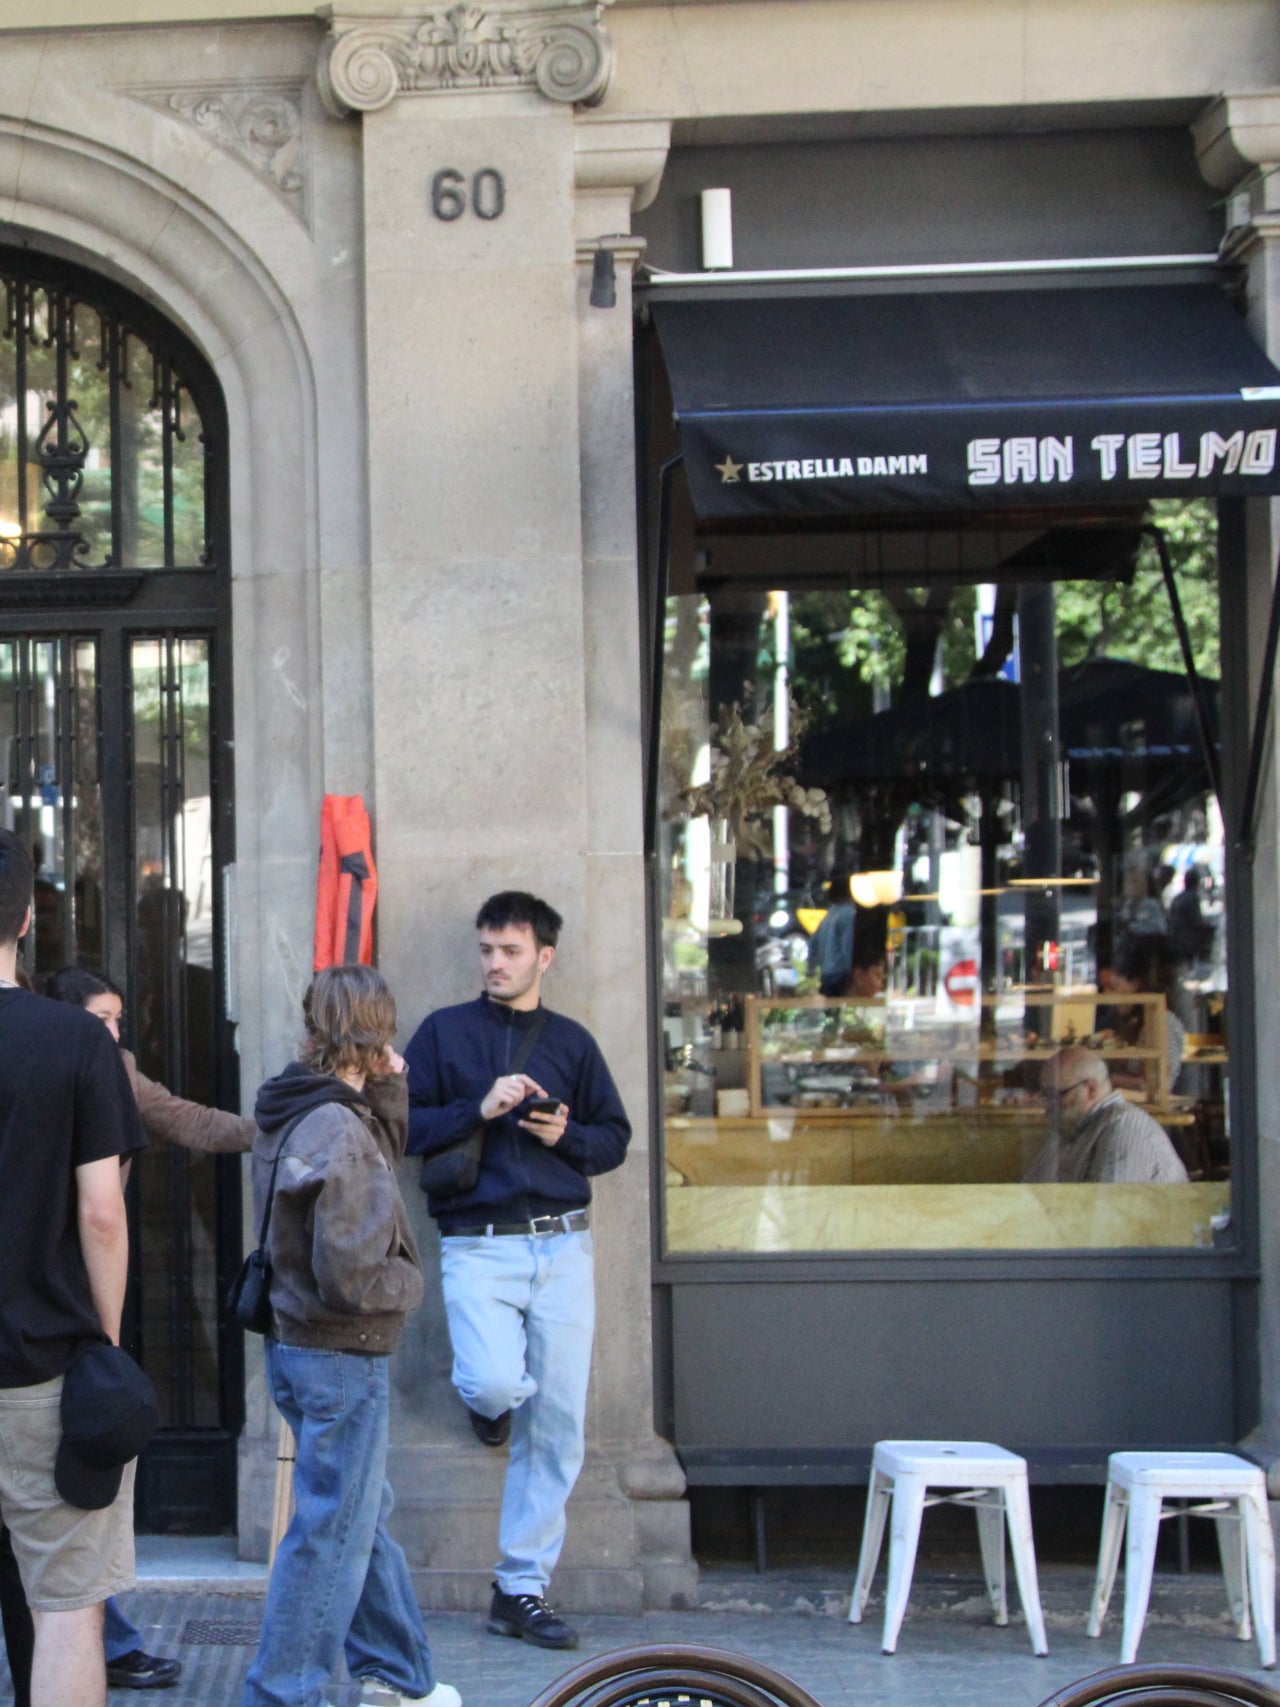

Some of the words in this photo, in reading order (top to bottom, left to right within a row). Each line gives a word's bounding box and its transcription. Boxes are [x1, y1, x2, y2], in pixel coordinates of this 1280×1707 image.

[432, 167, 505, 221] 60
[747, 457, 855, 483] ESTRELLA
[857, 453, 928, 476] DAMM
[967, 435, 1073, 485] SAN
[1091, 428, 1277, 480] TELMO
